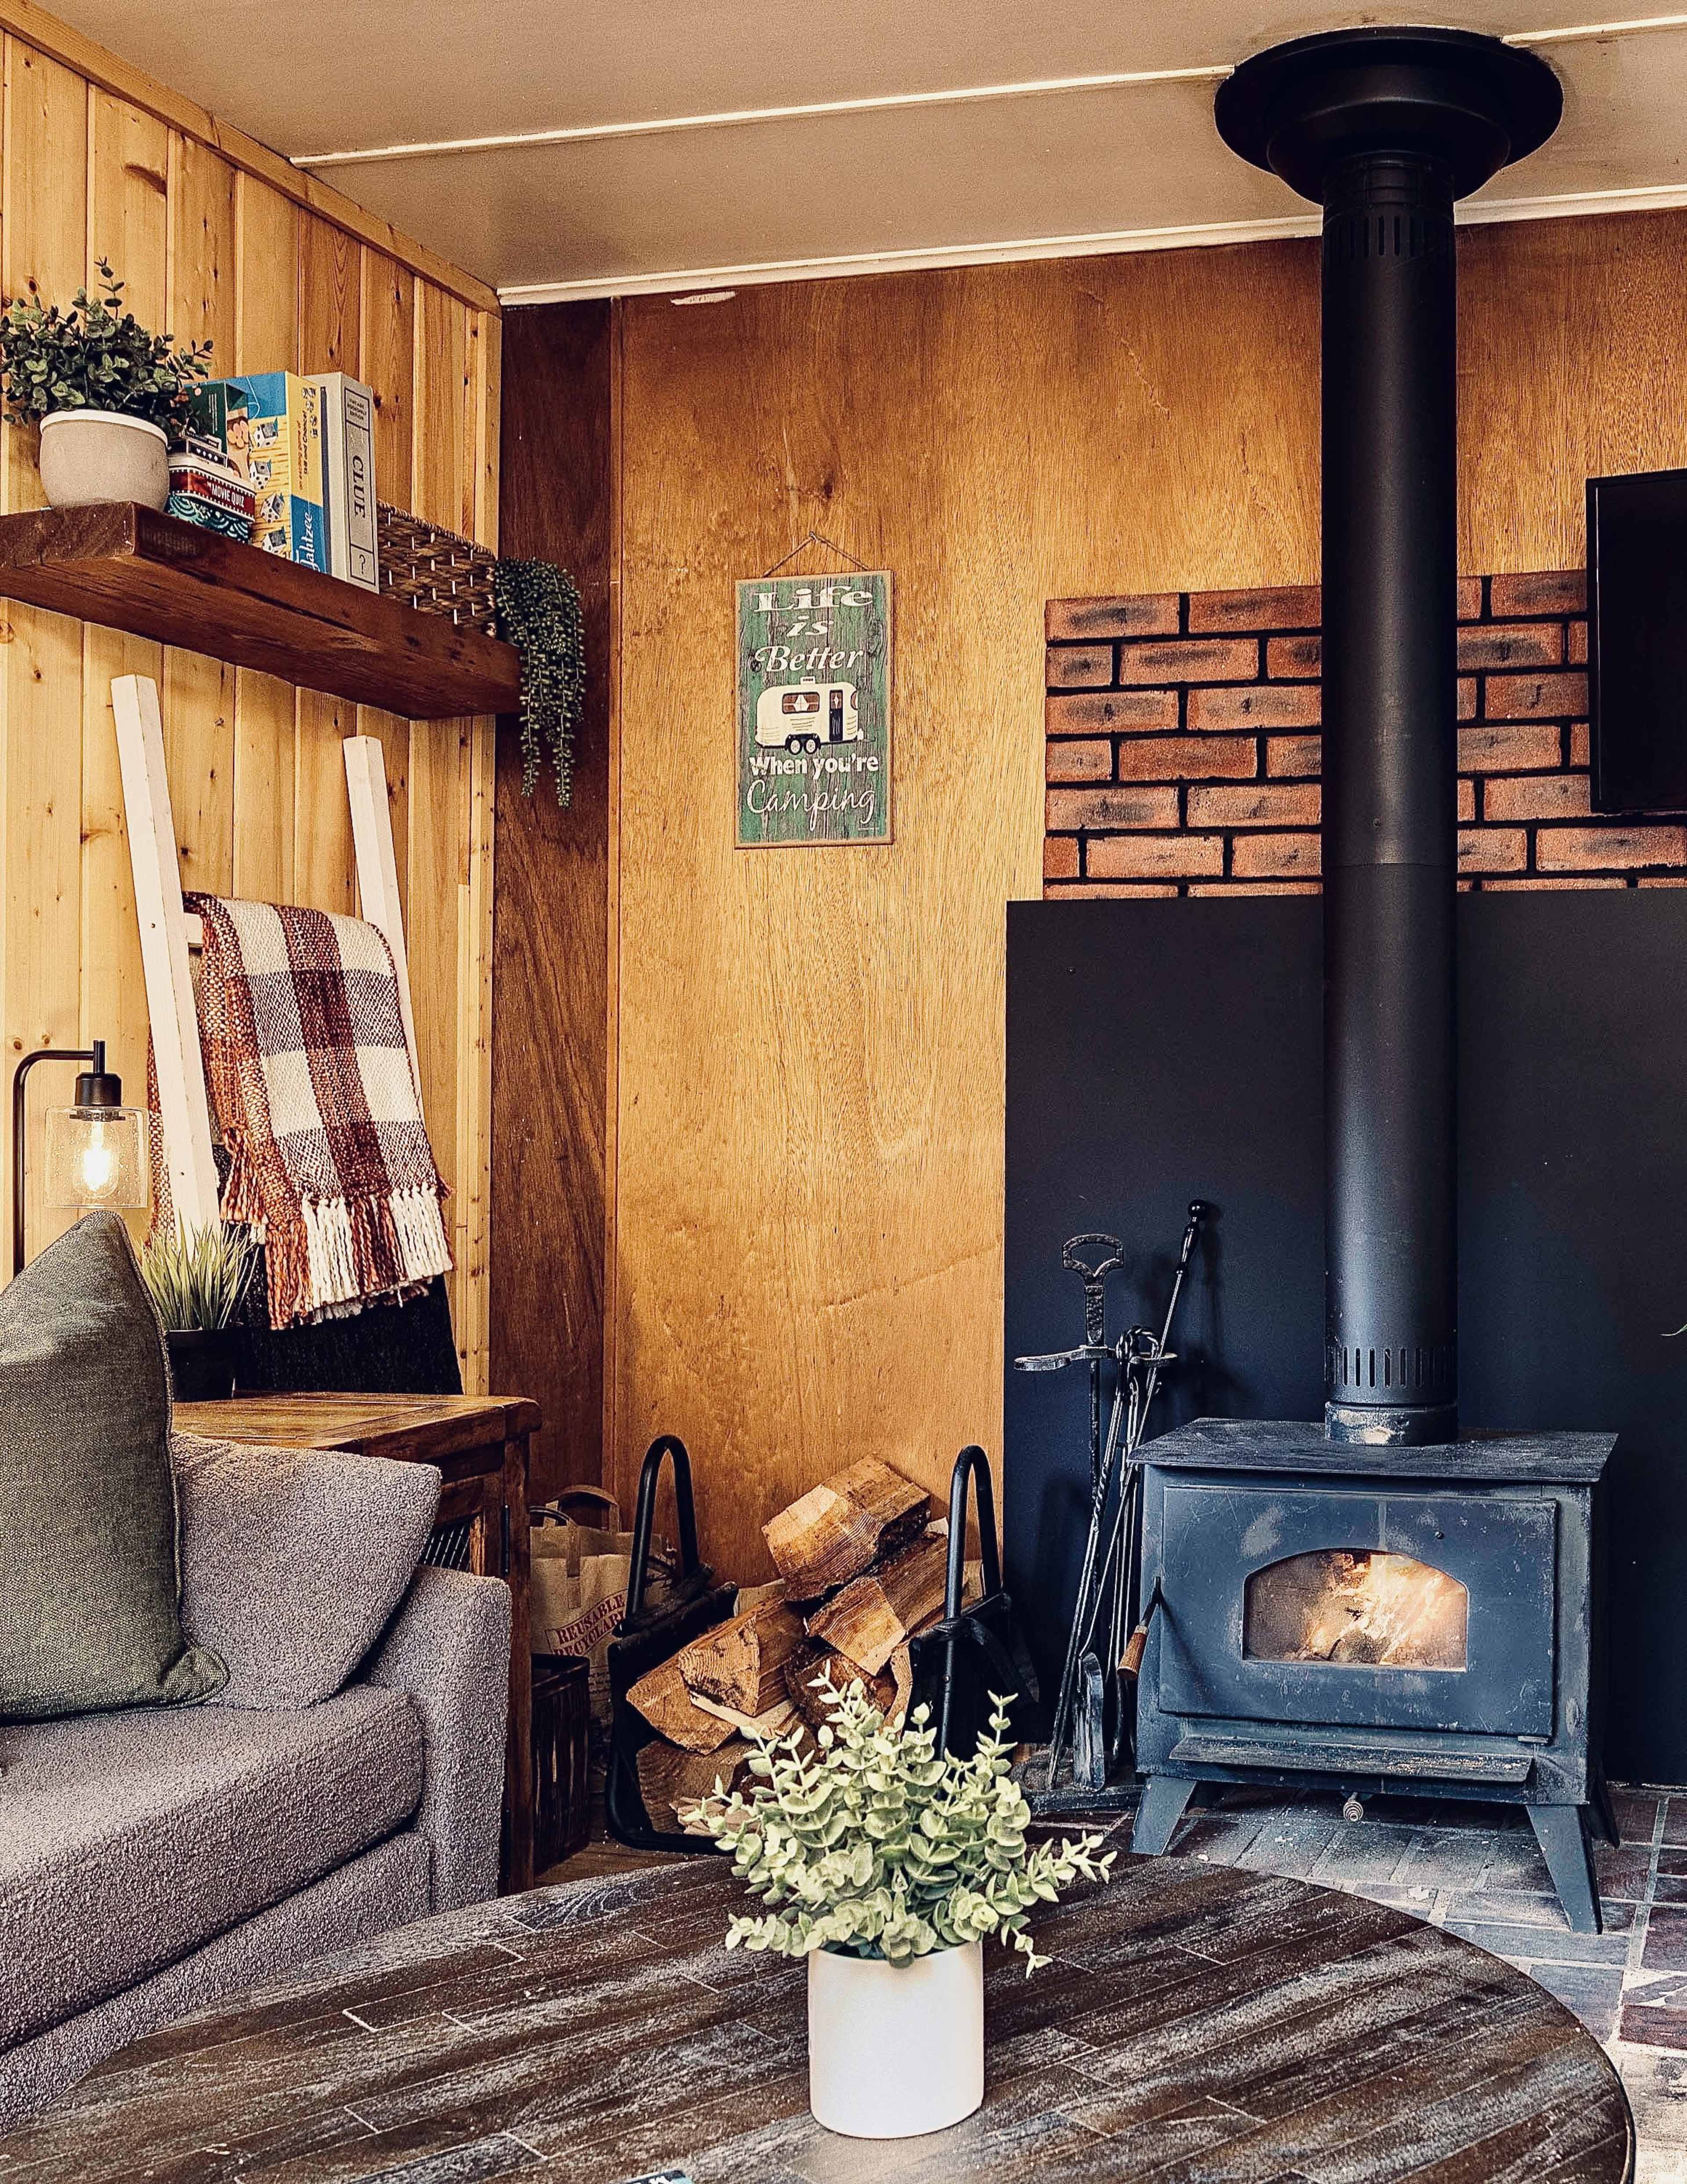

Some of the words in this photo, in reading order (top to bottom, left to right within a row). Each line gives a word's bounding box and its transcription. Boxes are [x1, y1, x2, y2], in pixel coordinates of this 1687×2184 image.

[212, 483, 230, 502] MOVIE
[231, 491, 244, 508] QUIZ
[352, 455, 366, 519] CLUE
[753, 585, 873, 612] Life
[786, 615, 834, 637] is
[754, 645, 864, 672] Better
[748, 756, 808, 776] When
[813, 753, 879, 780] you're
[747, 779, 876, 832] Camping
[556, 1595, 625, 1645] REUSABLE
